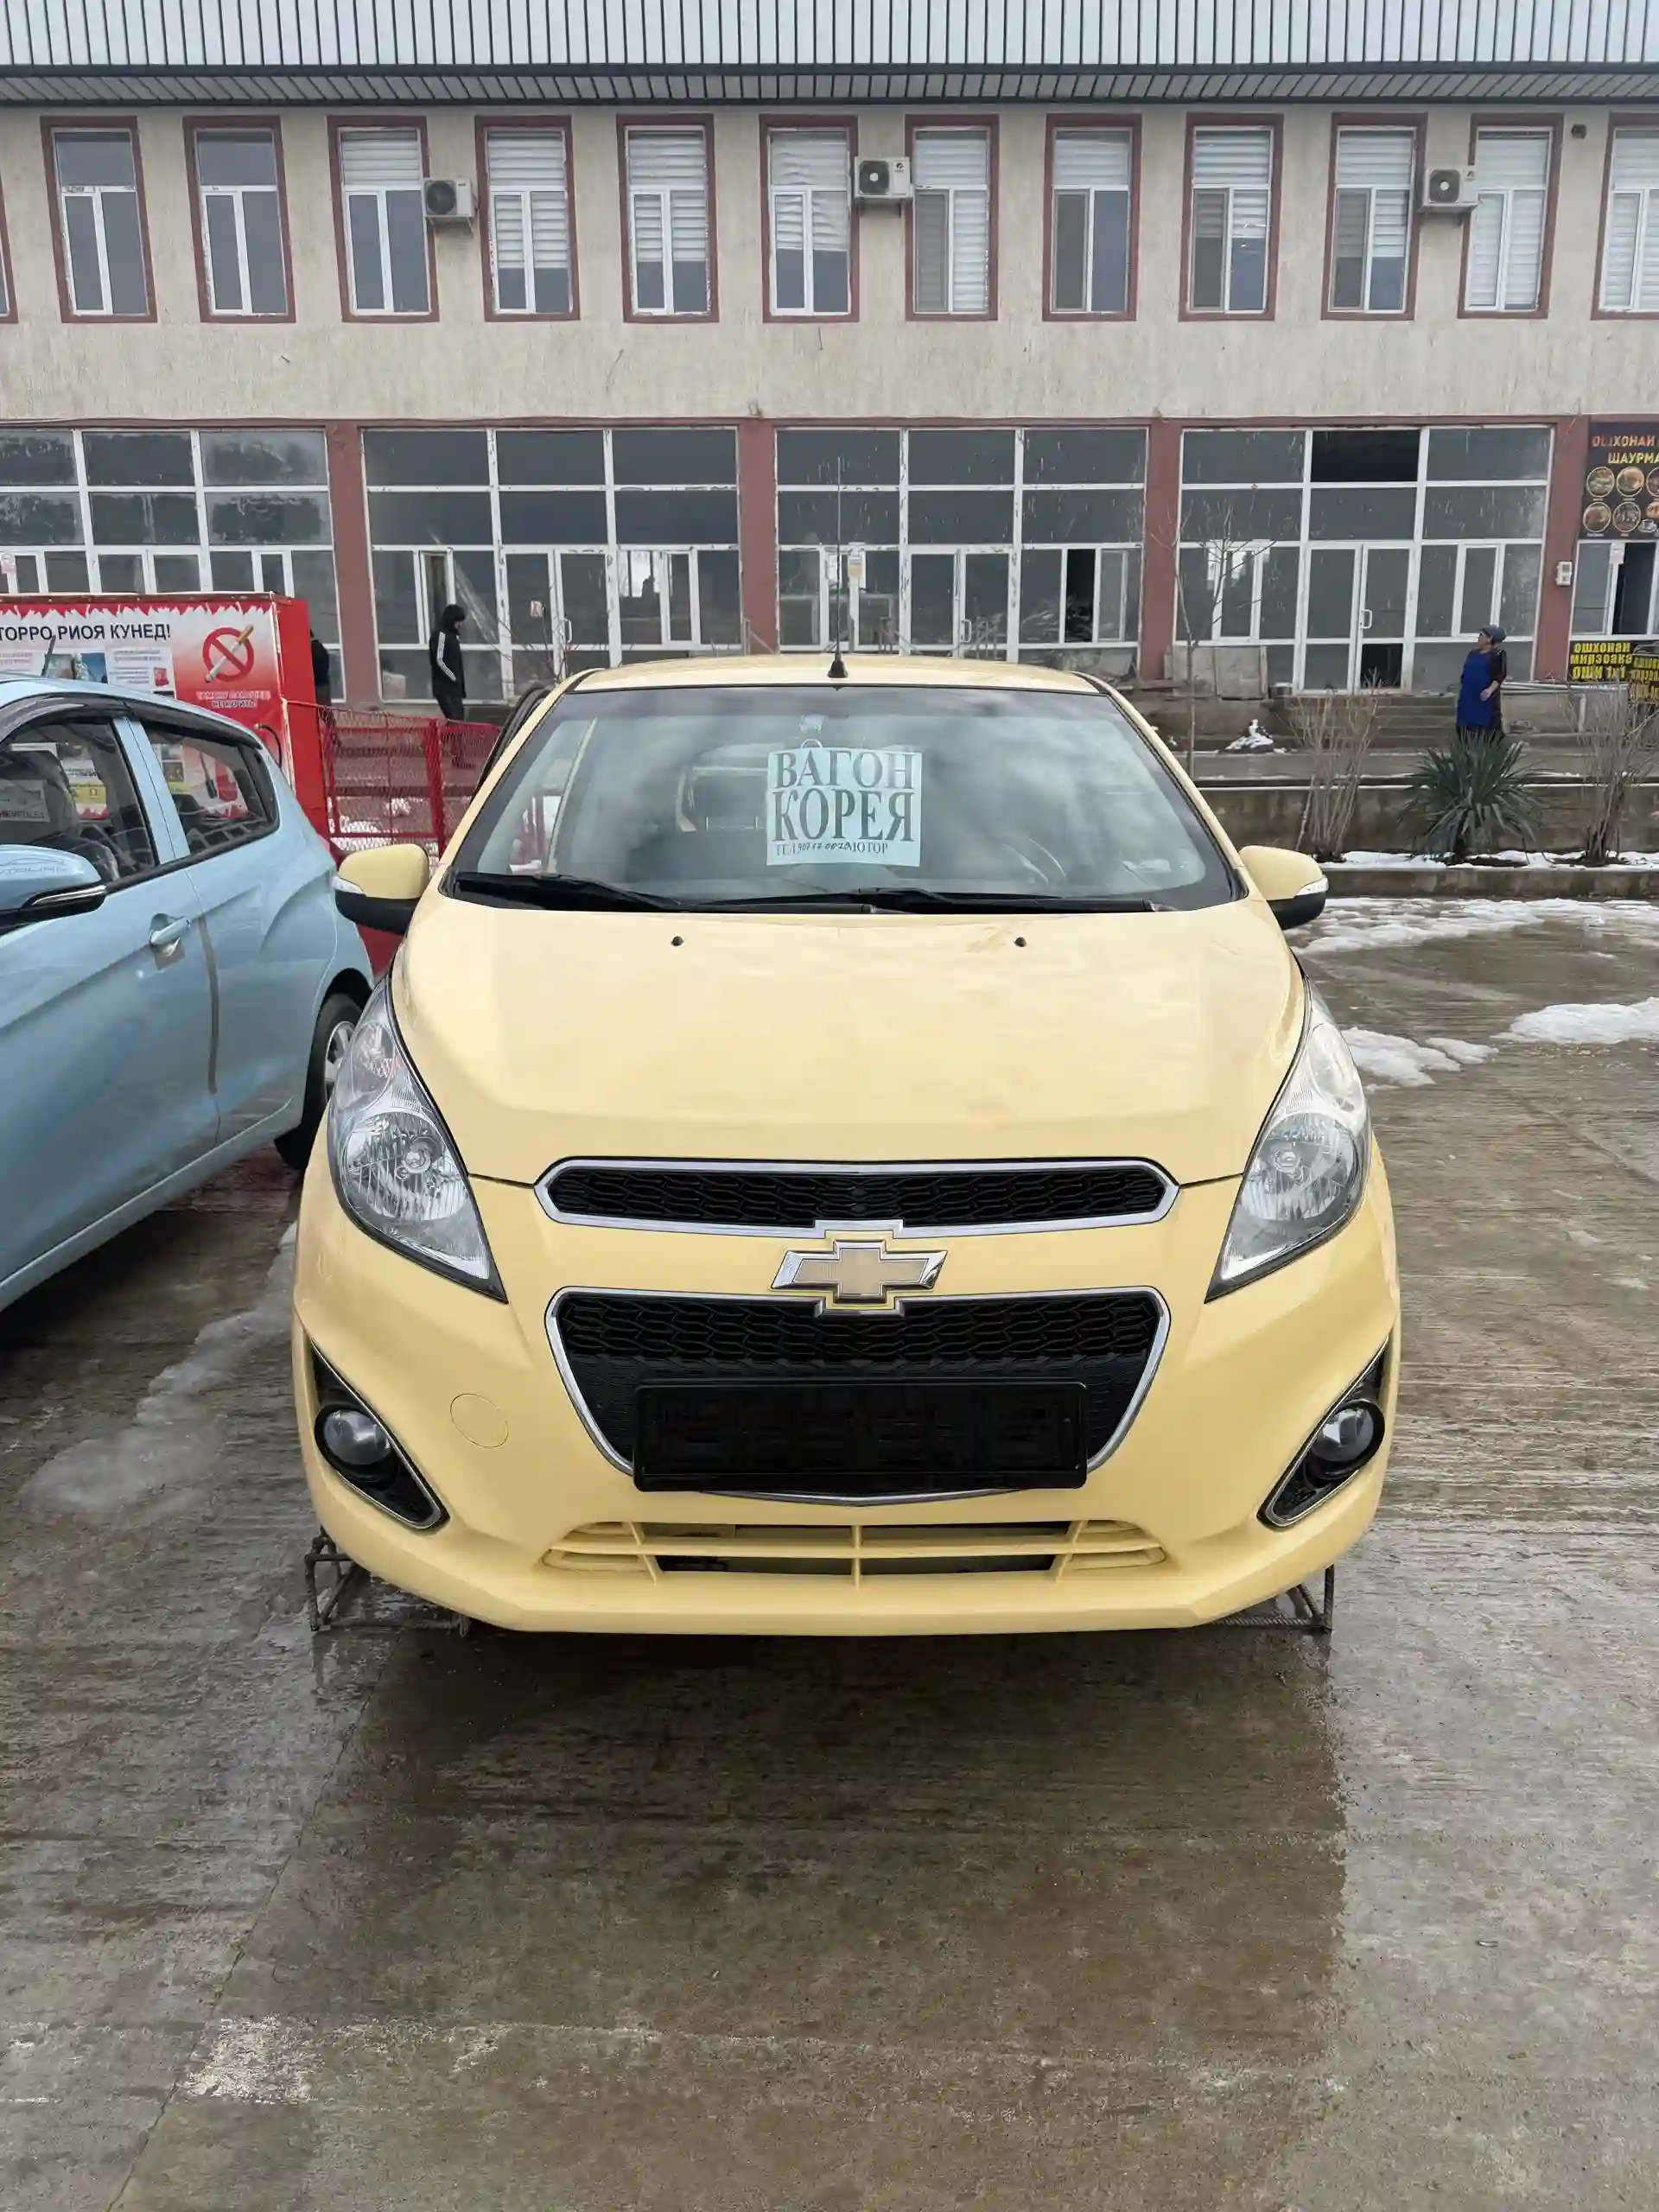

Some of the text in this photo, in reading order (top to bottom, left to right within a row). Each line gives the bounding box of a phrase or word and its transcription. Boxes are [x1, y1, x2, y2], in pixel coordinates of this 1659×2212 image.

[57, 624, 105, 640] РИОЯ
[110, 623, 171, 641] КУНЕД!
[774, 750, 916, 790] ВАГОН
[772, 788, 915, 842] КОРЕЯ
